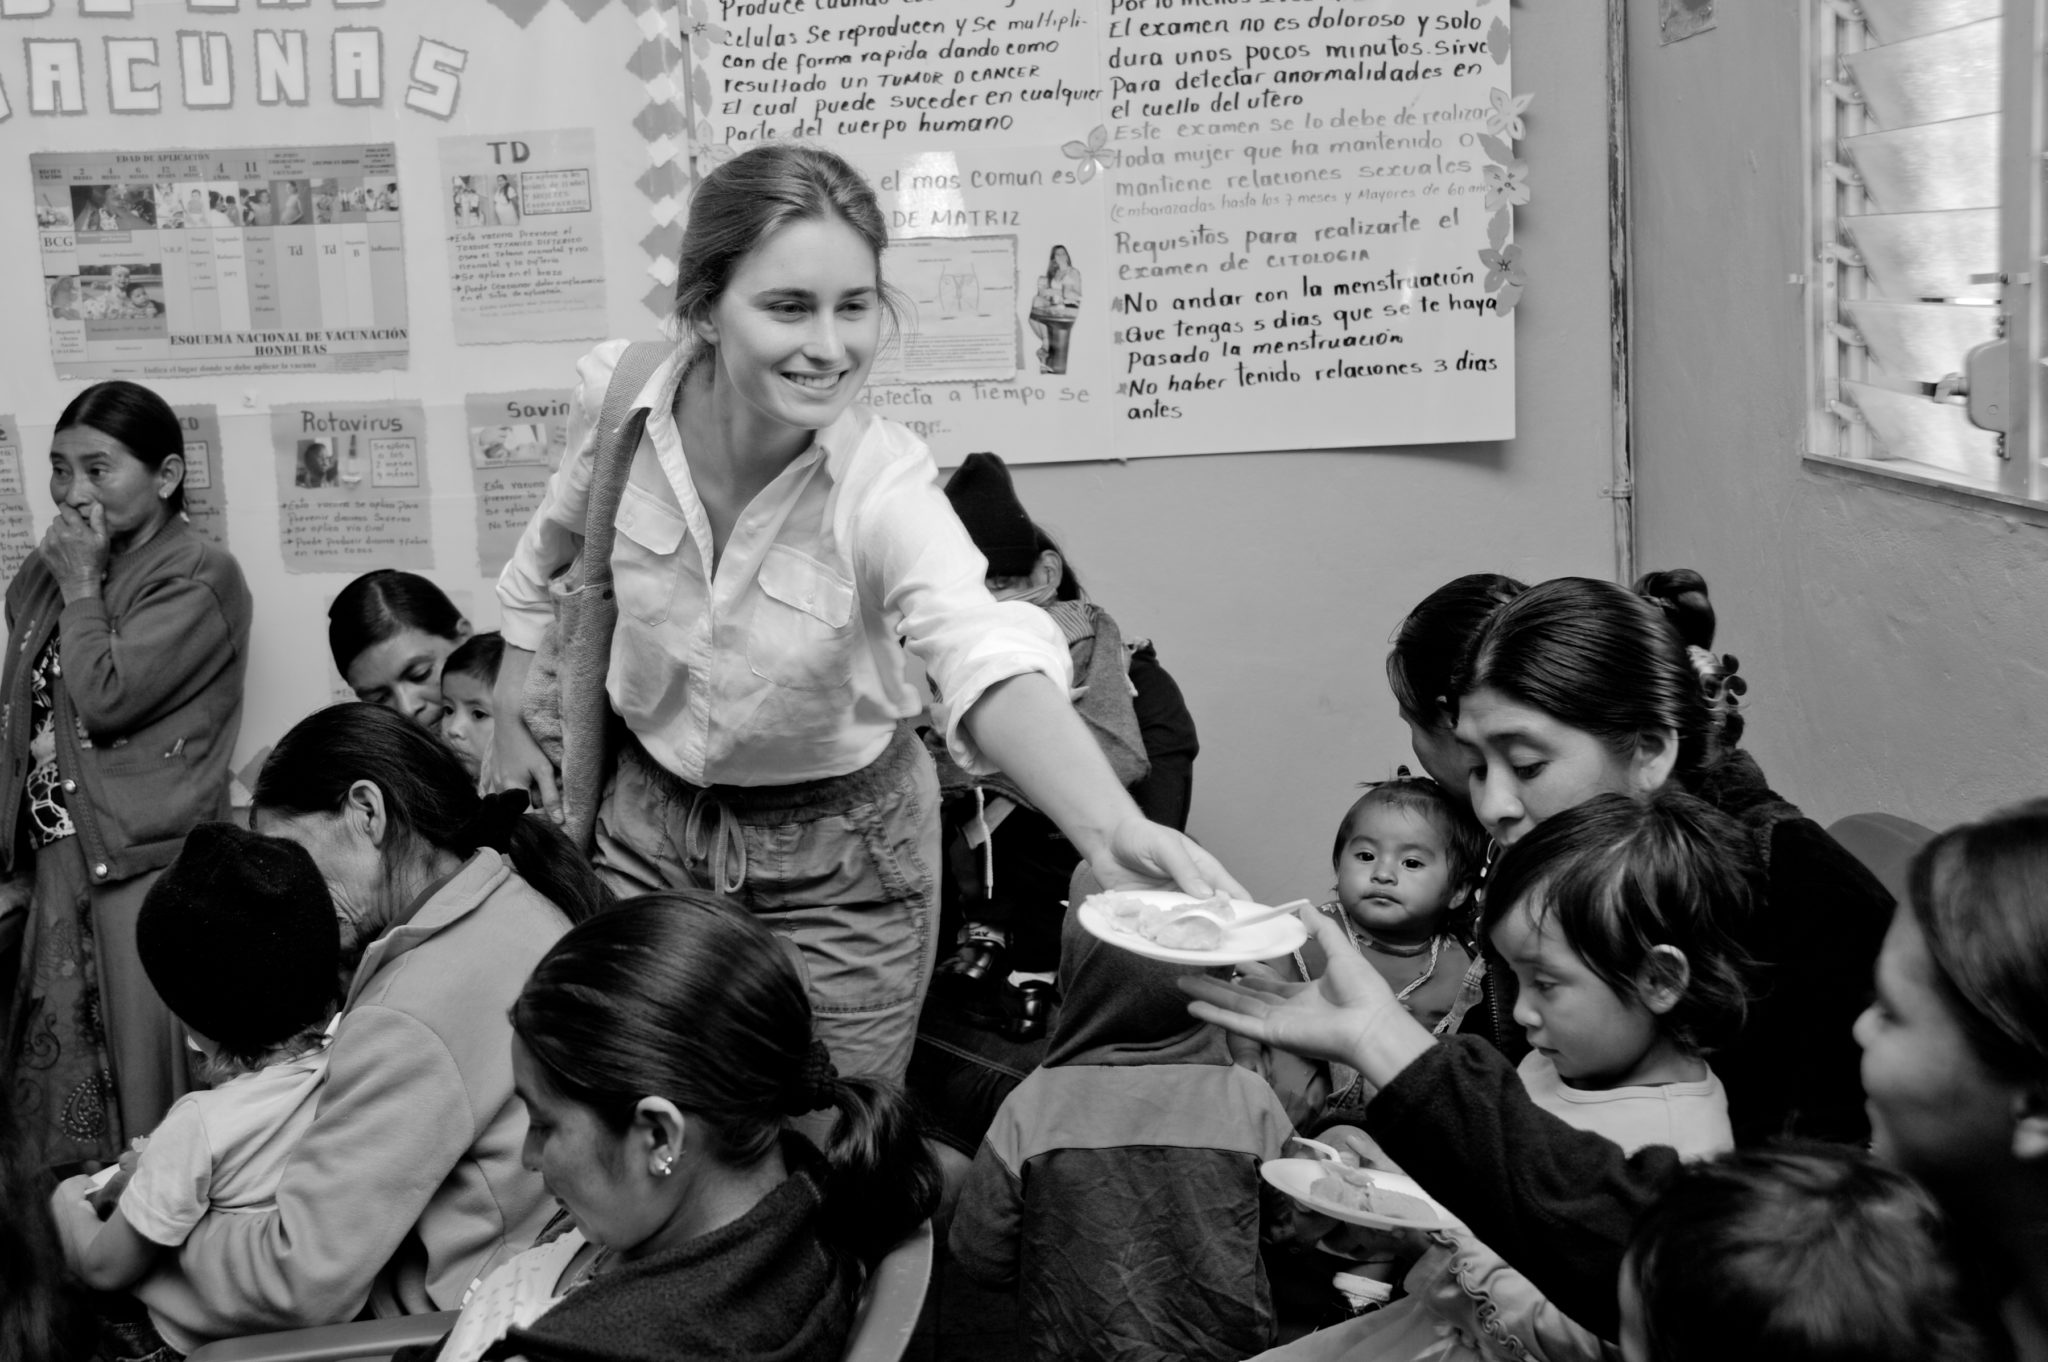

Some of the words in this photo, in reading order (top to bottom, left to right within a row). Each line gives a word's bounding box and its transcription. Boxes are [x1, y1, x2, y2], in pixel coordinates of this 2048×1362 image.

[839, 14, 945, 47] reproducen
[1109, 17, 1131, 38] El
[1139, 19, 1229, 37] examen
[1239, 17, 1265, 33] no
[1274, 17, 1300, 32] es
[1308, 6, 1405, 29] doloroso
[1418, 16, 1429, 37] y
[1435, 10, 1481, 30] solo
[723, 54, 755, 69] can
[762, 52, 788, 72] de
[796, 52, 852, 74] forma
[861, 40, 928, 67] rapida
[939, 38, 1000, 59] dando
[1006, 40, 1059, 56] como
[1108, 46, 1162, 69] dura
[1175, 48, 1232, 66] unos
[1246, 44, 1310, 69] pocos
[0, 24, 470, 122] ACUNAS
[724, 67, 826, 93] resultado
[841, 76, 867, 89] un
[878, 71, 944, 88] TUMOR
[971, 64, 1040, 83] CANCER
[1175, 65, 1266, 91] detectar
[1273, 61, 1442, 84] anormalidades
[1454, 61, 1482, 77] en
[722, 100, 739, 116] El
[753, 92, 797, 117] cual
[815, 93, 876, 120] puede
[890, 86, 978, 110] suceder
[985, 87, 1012, 106] en
[1020, 80, 1103, 107] cualquier
[1111, 102, 1129, 119] el
[1142, 98, 1200, 117] cuello
[1210, 93, 1239, 113] del
[1247, 88, 1303, 110] utero
[793, 117, 822, 138] del
[837, 116, 906, 140] cuerpo
[918, 112, 1014, 134] humano
[1115, 123, 1161, 140] Este
[1176, 121, 1259, 137] examen
[1270, 118, 1294, 132] se
[1305, 112, 1323, 130] lo
[1330, 107, 1387, 128] debe
[486, 140, 531, 165] TD
[1174, 146, 1231, 168] mujer
[1243, 144, 1282, 165] que
[1291, 137, 1319, 156] ha
[1329, 129, 1442, 154] mantenido
[881, 170, 899, 191] el
[912, 174, 961, 191] mas
[1052, 170, 1076, 184] es
[1116, 174, 1212, 197] mantiene
[1227, 167, 1342, 189] relaciones
[1358, 154, 1472, 179] sexuales
[1221, 193, 1257, 209] hasta
[1262, 193, 1280, 207] los
[893, 210, 919, 229] DE
[931, 209, 1021, 227] MATRIZ
[43, 235, 73, 248] BCG
[323, 243, 337, 255] Td
[1115, 223, 1229, 262] Requisitos
[1245, 229, 1297, 253] para
[1315, 210, 1421, 241] realizarte
[1439, 207, 1460, 228] el
[288, 244, 303, 256] Td
[1119, 261, 1208, 281] examen
[1220, 252, 1248, 273] de
[1266, 248, 1370, 268] CITOLOGIA
[1123, 292, 1158, 314] No
[1172, 289, 1243, 309] andar
[1255, 288, 1288, 305] con
[1302, 275, 1323, 297] la
[1174, 318, 1244, 343] tengas
[1333, 306, 1373, 332] que
[1383, 301, 1410, 317] se
[1421, 296, 1440, 313] te
[1449, 294, 1498, 316] haya
[170, 333, 232, 346] ESQUEMA
[236, 331, 300, 345] NACIONAL
[302, 331, 321, 342] DE
[326, 327, 408, 342] VACUNACIÓN
[255, 343, 327, 357] HONDURAS
[1222, 341, 1241, 358] la
[1128, 377, 1158, 397] No
[1168, 371, 1228, 393] haber
[1238, 359, 1300, 388] tenido
[1315, 359, 1423, 382] relaciones
[1434, 359, 1448, 373] 3
[949, 390, 961, 402] a
[1128, 399, 1183, 420] antes
[300, 410, 403, 433] Rotavirus
